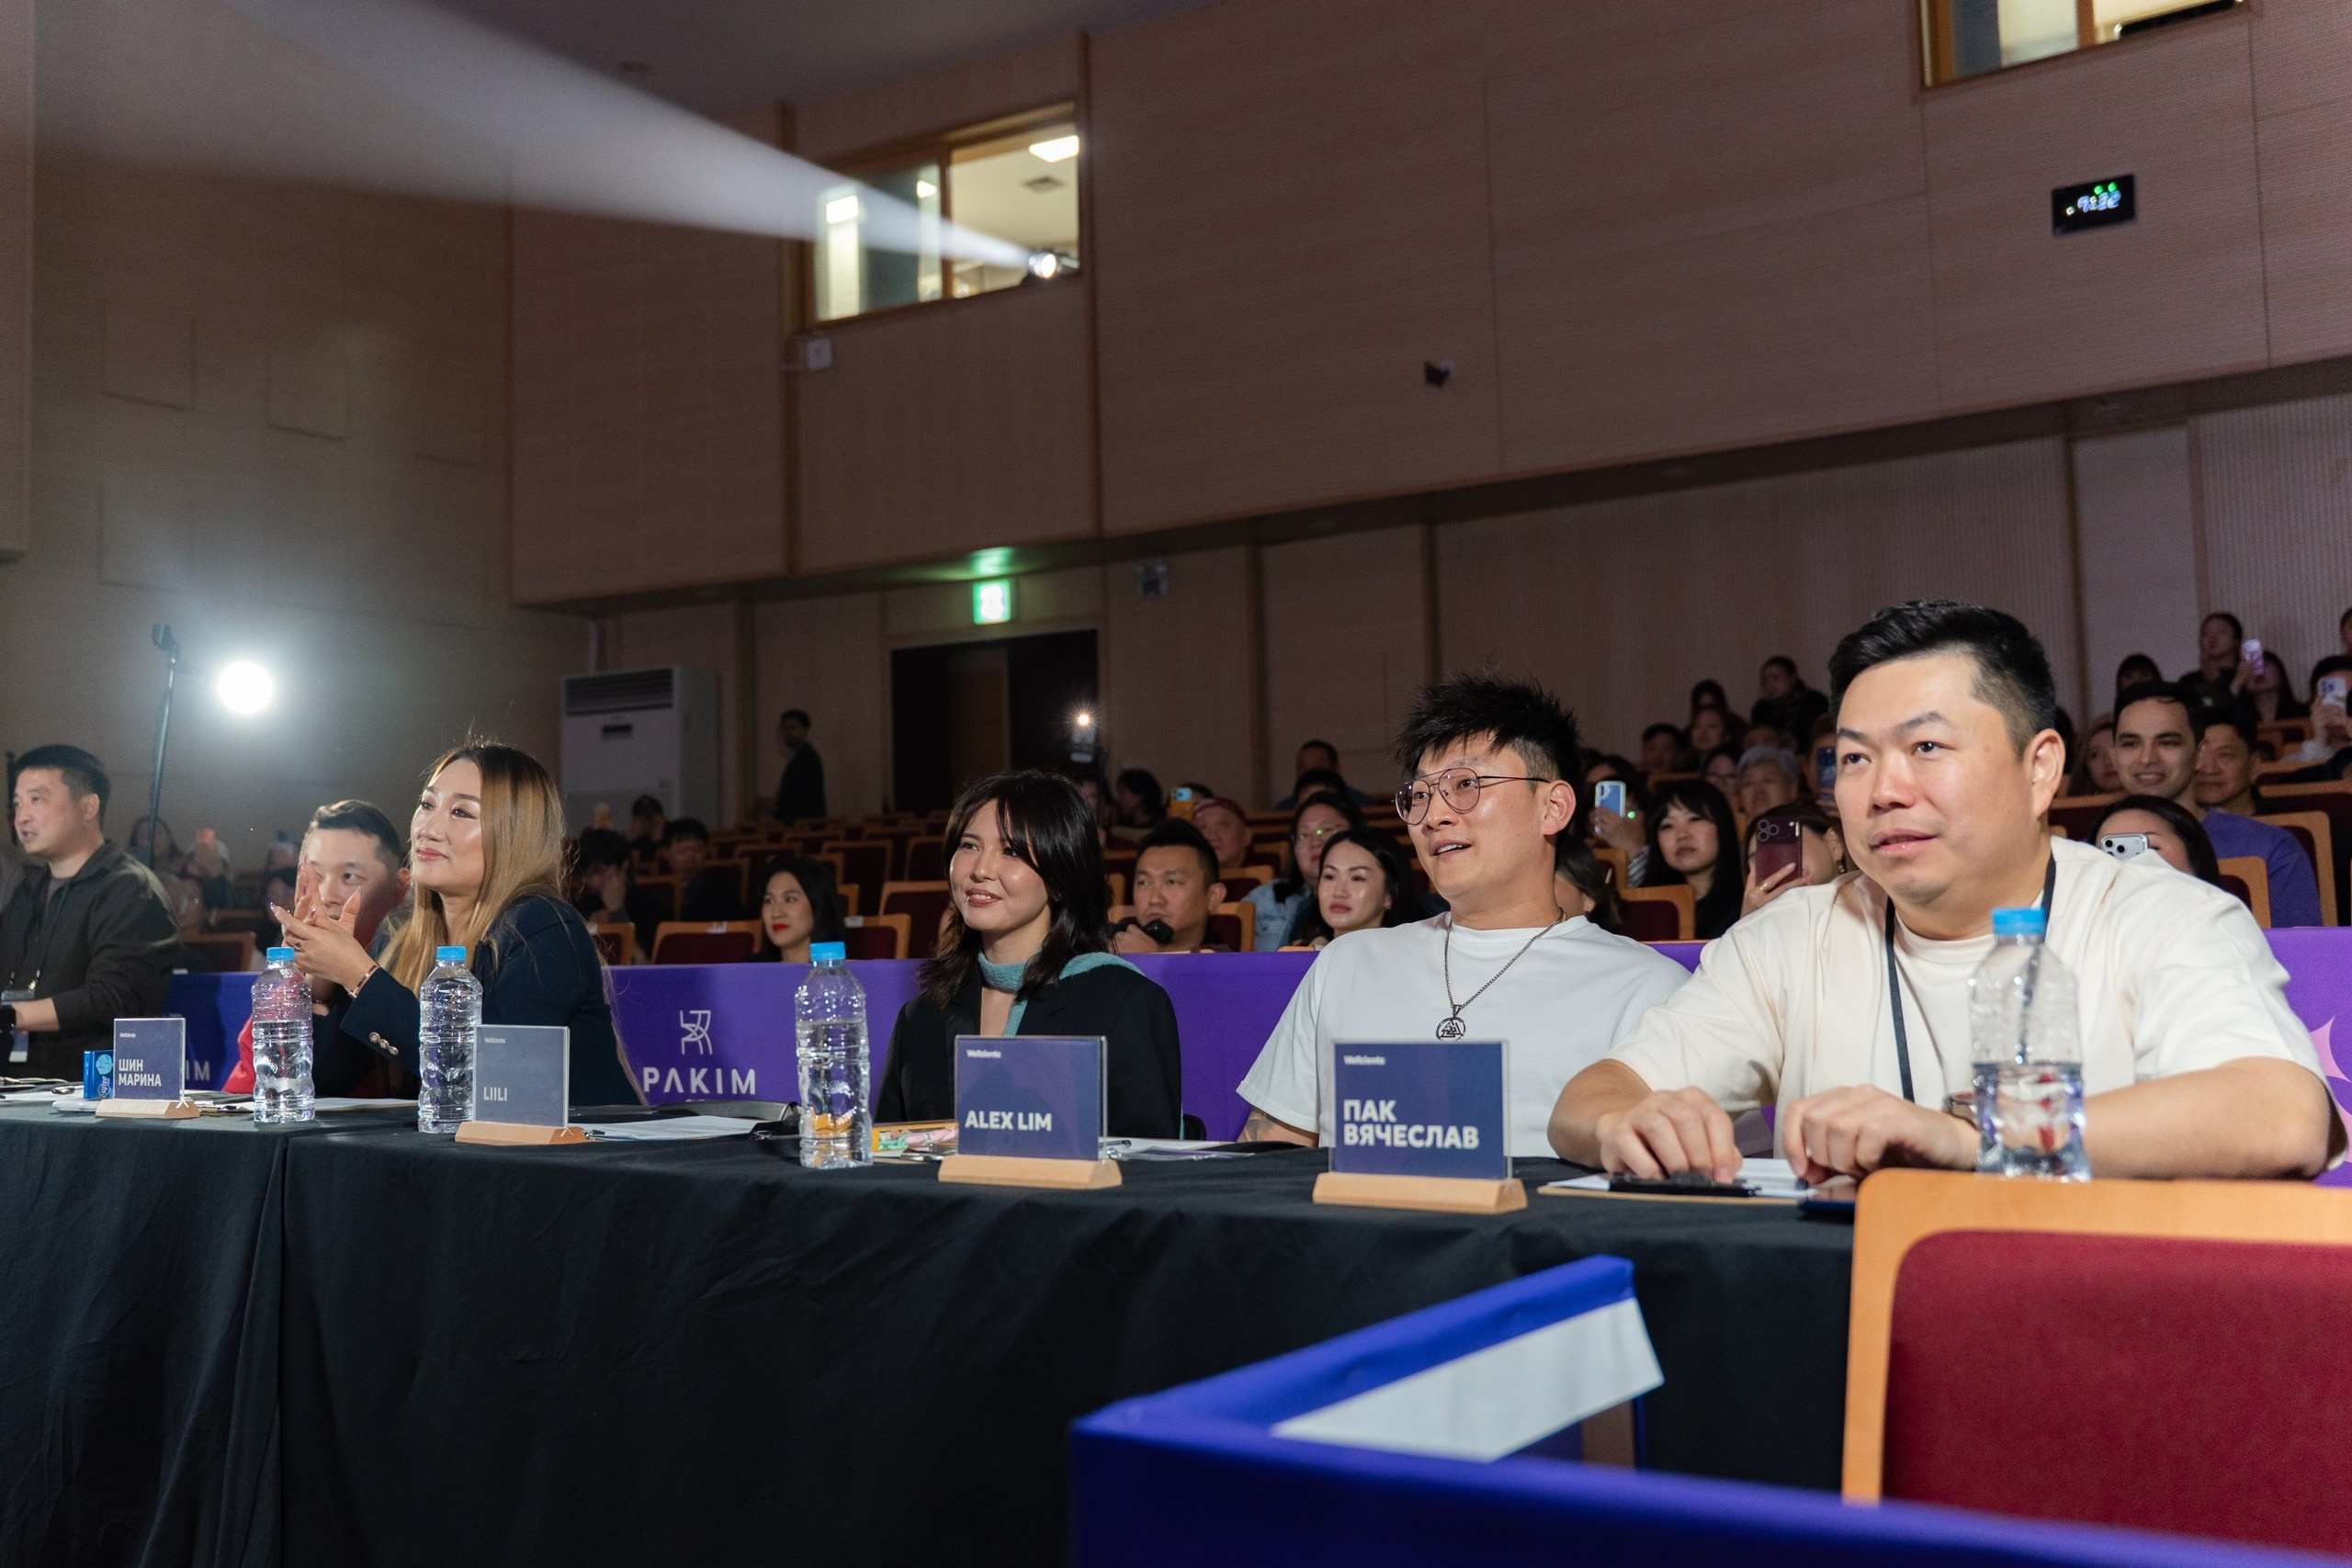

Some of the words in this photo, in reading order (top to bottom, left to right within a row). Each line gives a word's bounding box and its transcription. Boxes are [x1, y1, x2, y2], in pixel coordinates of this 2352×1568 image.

[119, 1059, 143, 1072] ШИН
[119, 1074, 162, 1087] МАРИНА
[643, 1066, 756, 1095] PAKIM
[965, 1110, 1014, 1131] ALEX
[1017, 1112, 1053, 1132] LIM
[1343, 1099, 1397, 1122] ПАК
[1343, 1123, 1480, 1149] ВЯЧЕСЛАВ
